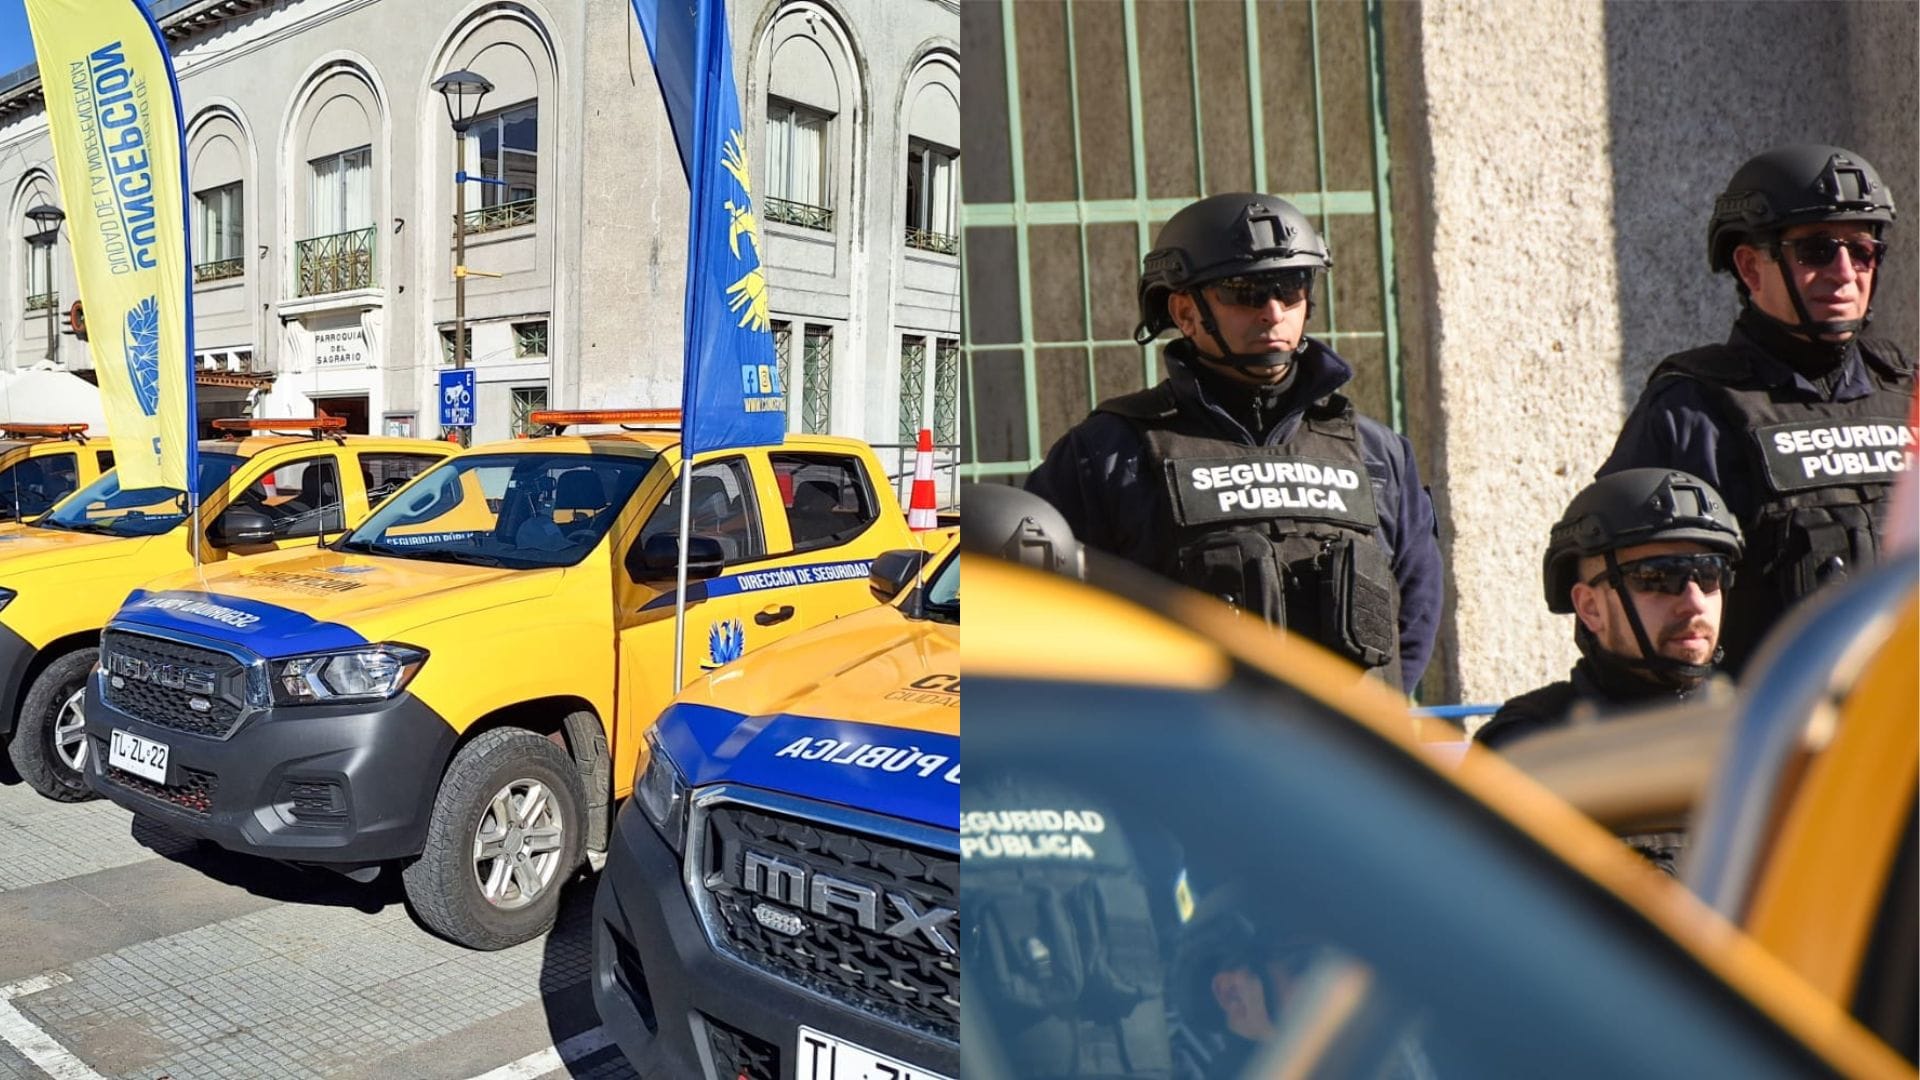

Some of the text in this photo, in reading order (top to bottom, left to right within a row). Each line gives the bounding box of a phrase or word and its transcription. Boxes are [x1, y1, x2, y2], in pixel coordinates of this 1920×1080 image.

[315, 331, 362, 343] PARROQUIA
[316, 352, 361, 365] SAGRARIO
[1192, 462, 1360, 490] SEGURIDAD
[1218, 485, 1348, 512] PÚBLICA
[737, 568, 798, 591] DIRECCIÓN
[797, 569, 814, 584] DE
[815, 562, 870, 581] SEGURIDAD
[960, 831, 1096, 859] PÚBLICA
